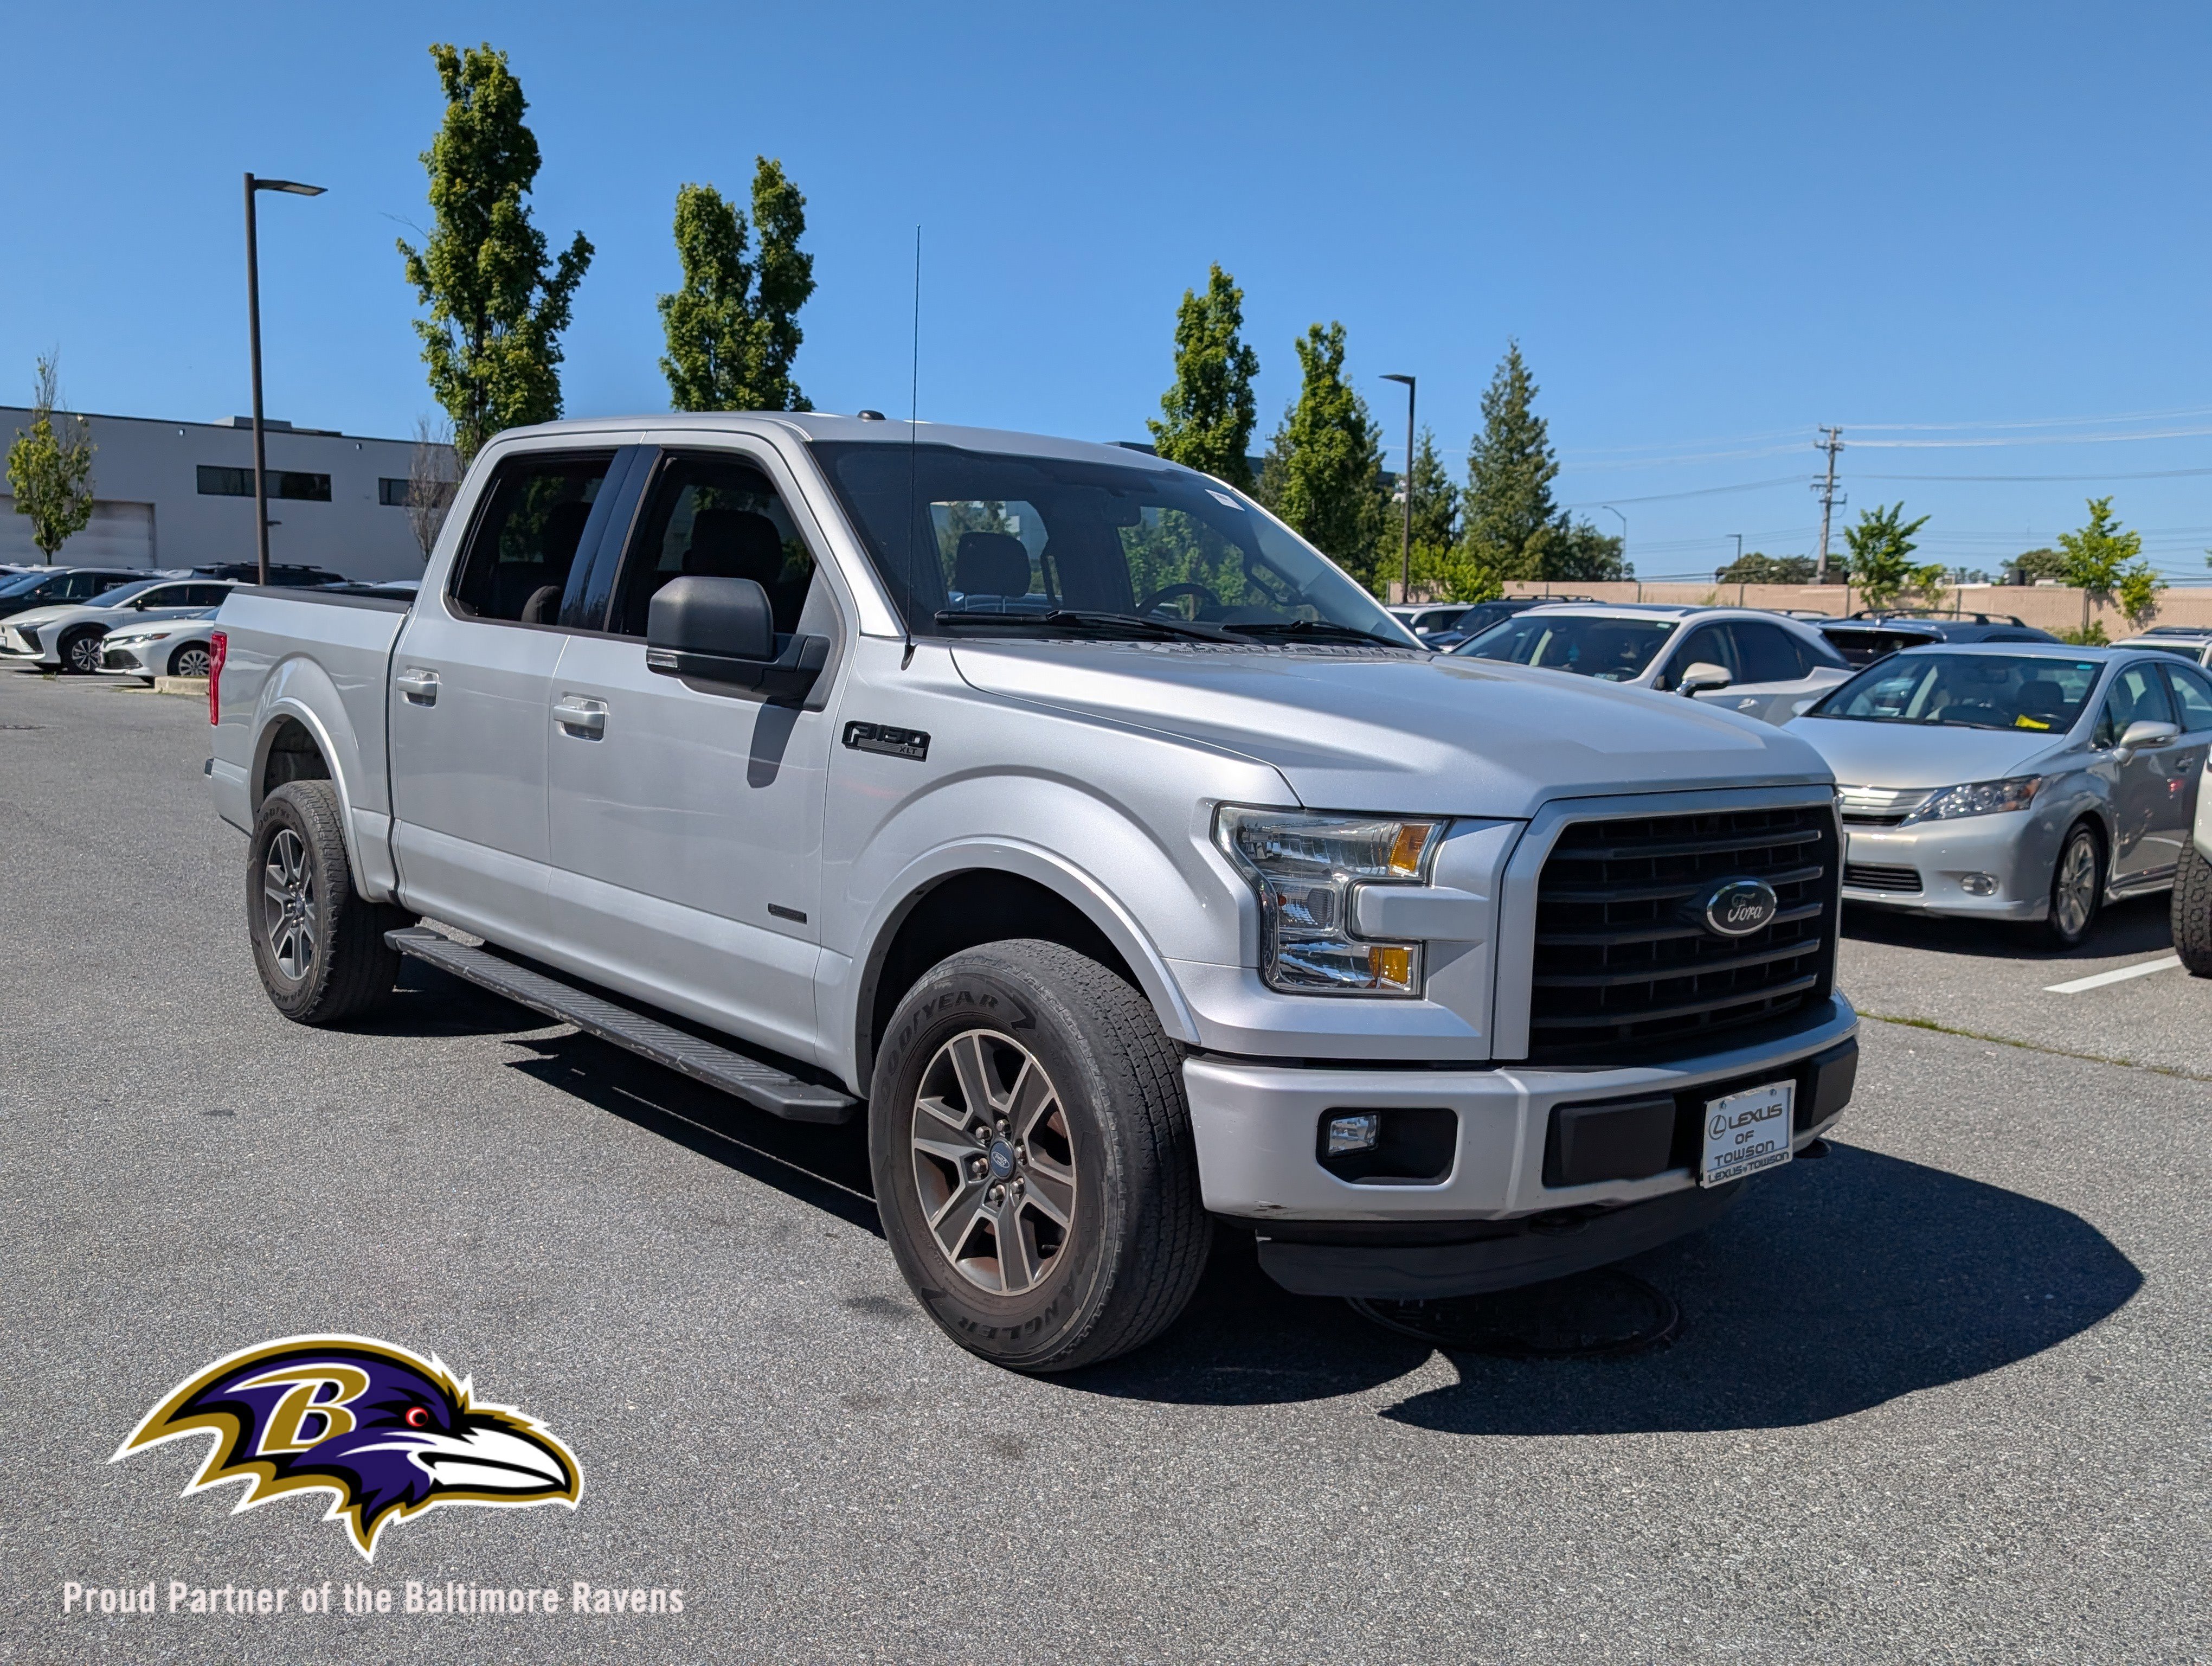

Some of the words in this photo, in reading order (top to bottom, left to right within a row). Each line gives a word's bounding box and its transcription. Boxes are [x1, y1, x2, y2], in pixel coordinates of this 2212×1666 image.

[899, 746, 918, 754] XLT
[1727, 893, 1764, 922] Ford
[1728, 1103, 1783, 1129] LEXUS
[1735, 1130, 1754, 1144] OF
[1714, 1140, 1774, 1166] TOWSON
[1708, 1165, 1742, 1183] LEXUS
